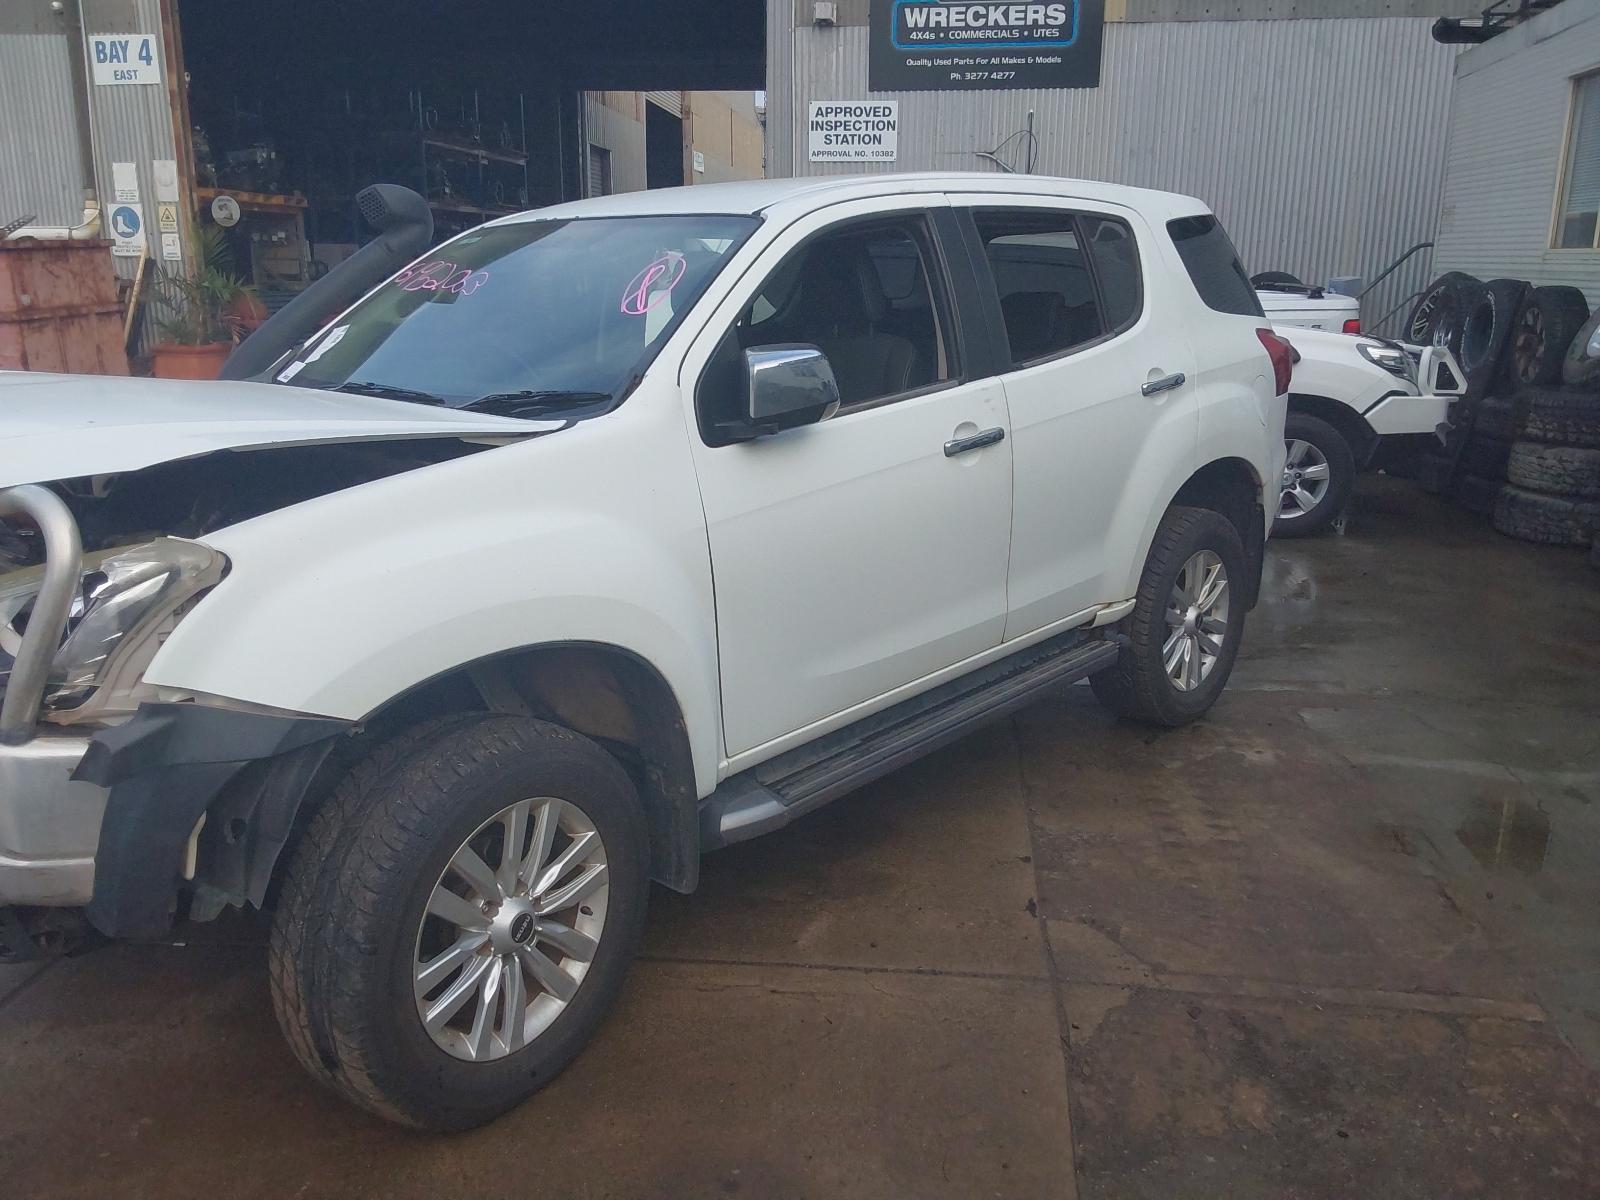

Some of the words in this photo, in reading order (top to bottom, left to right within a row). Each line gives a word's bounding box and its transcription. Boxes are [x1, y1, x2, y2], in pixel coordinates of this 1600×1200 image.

[904, 3, 1066, 28] WRECKERS
[948, 29, 1019, 39] COMMERCIALS
[1033, 28, 1060, 37] UTES
[95, 40, 129, 64] BAY
[138, 38, 153, 66] 4
[906, 58, 932, 67] Quality
[933, 58, 952, 66] Used
[975, 57, 989, 65] For
[990, 57, 1000, 65] All
[1001, 56, 1026, 64] Makes
[1027, 56, 1034, 64] &
[1035, 56, 1062, 64] Models
[113, 69, 138, 80] EAST
[950, 72, 963, 80] Ph.
[964, 72, 989, 80] 3277
[990, 71, 1016, 80] 4277
[814, 106, 893, 118] APPROVED
[810, 120, 896, 132] INSPECTION
[823, 133, 882, 146] STATION
[811, 150, 853, 158] APPROVAL
[854, 150, 869, 158] NO.
[870, 150, 895, 158] 10382
